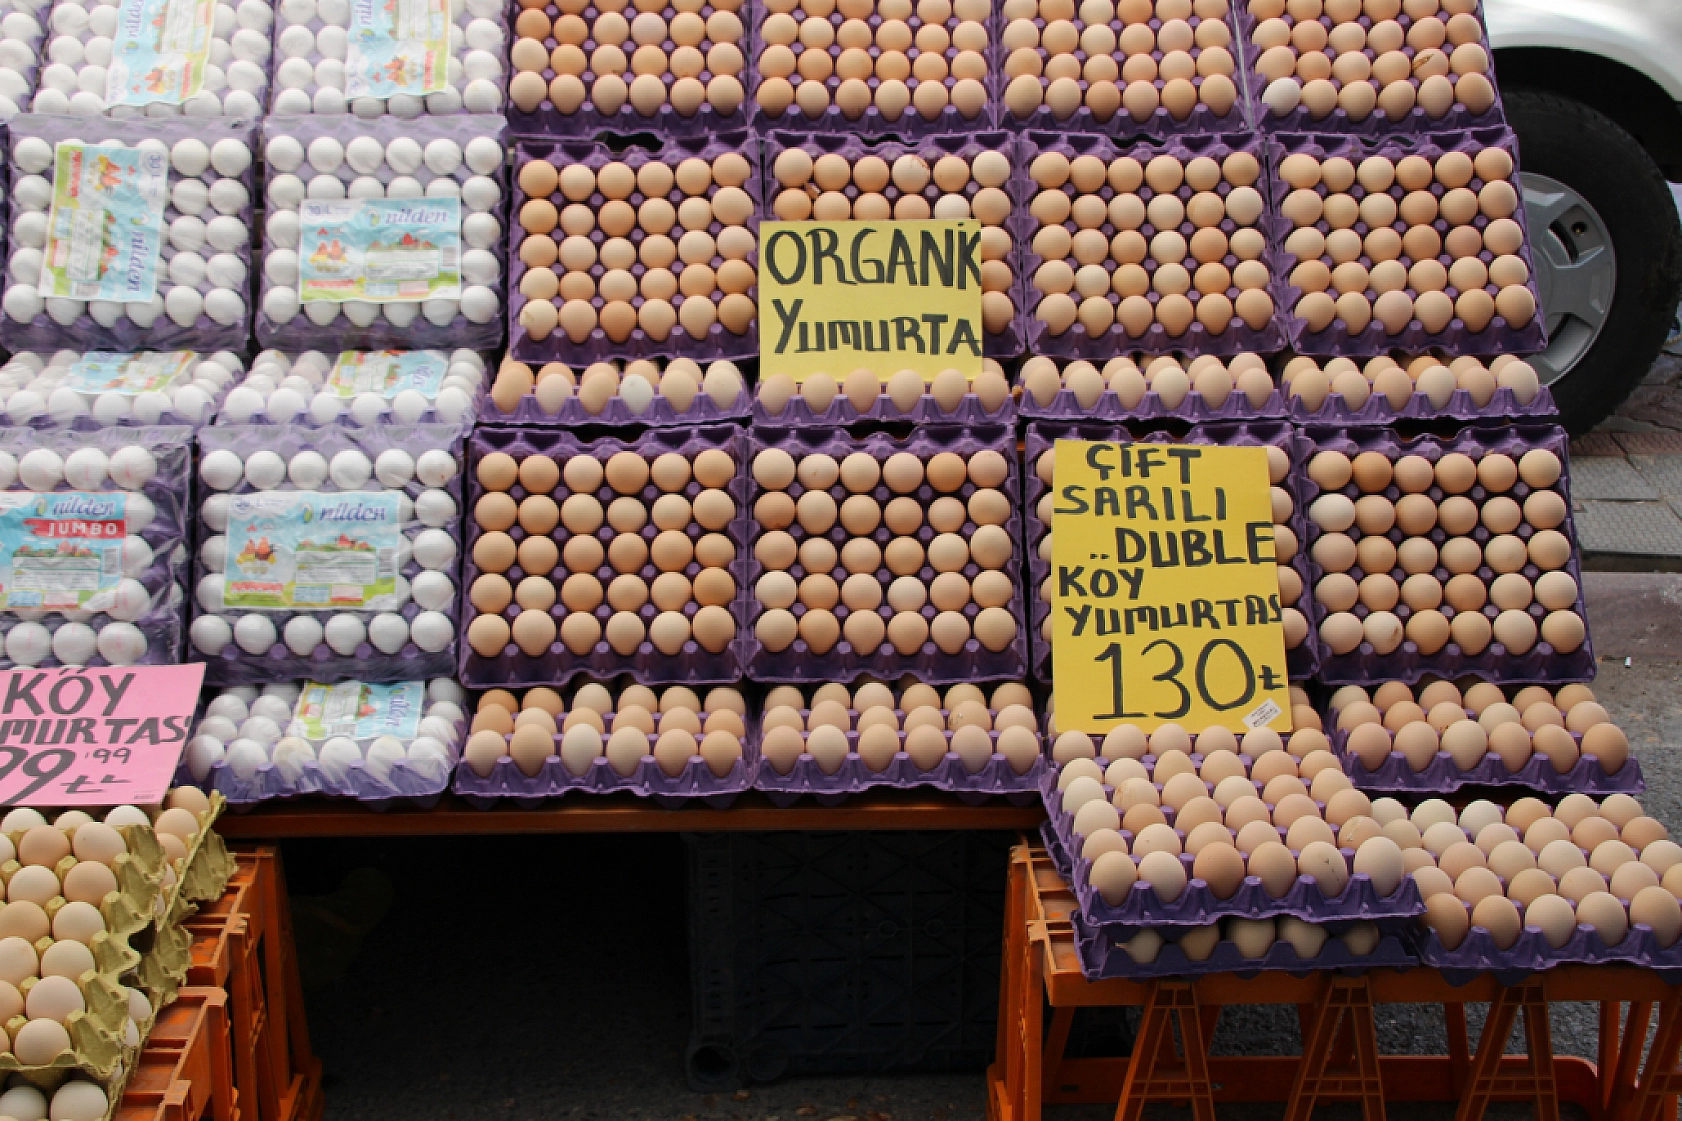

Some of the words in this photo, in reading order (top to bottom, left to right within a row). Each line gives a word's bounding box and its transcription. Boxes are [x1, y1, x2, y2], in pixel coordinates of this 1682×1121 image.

[386, 207, 448, 225] nilden
[127, 230, 149, 292] nilden
[772, 299, 981, 357] YUMURTA
[1087, 443, 1202, 484] ÇİFT
[53, 496, 115, 516] nilden
[320, 503, 387, 521] nilden
[1054, 485, 1227, 523] SARILI
[48, 522, 118, 537] JUMBO
[1115, 522, 1275, 567] DUBLE
[1059, 553, 1144, 600] KÖY
[1064, 594, 1282, 637] YUMURTAS
[2, 668, 136, 716] KÖY
